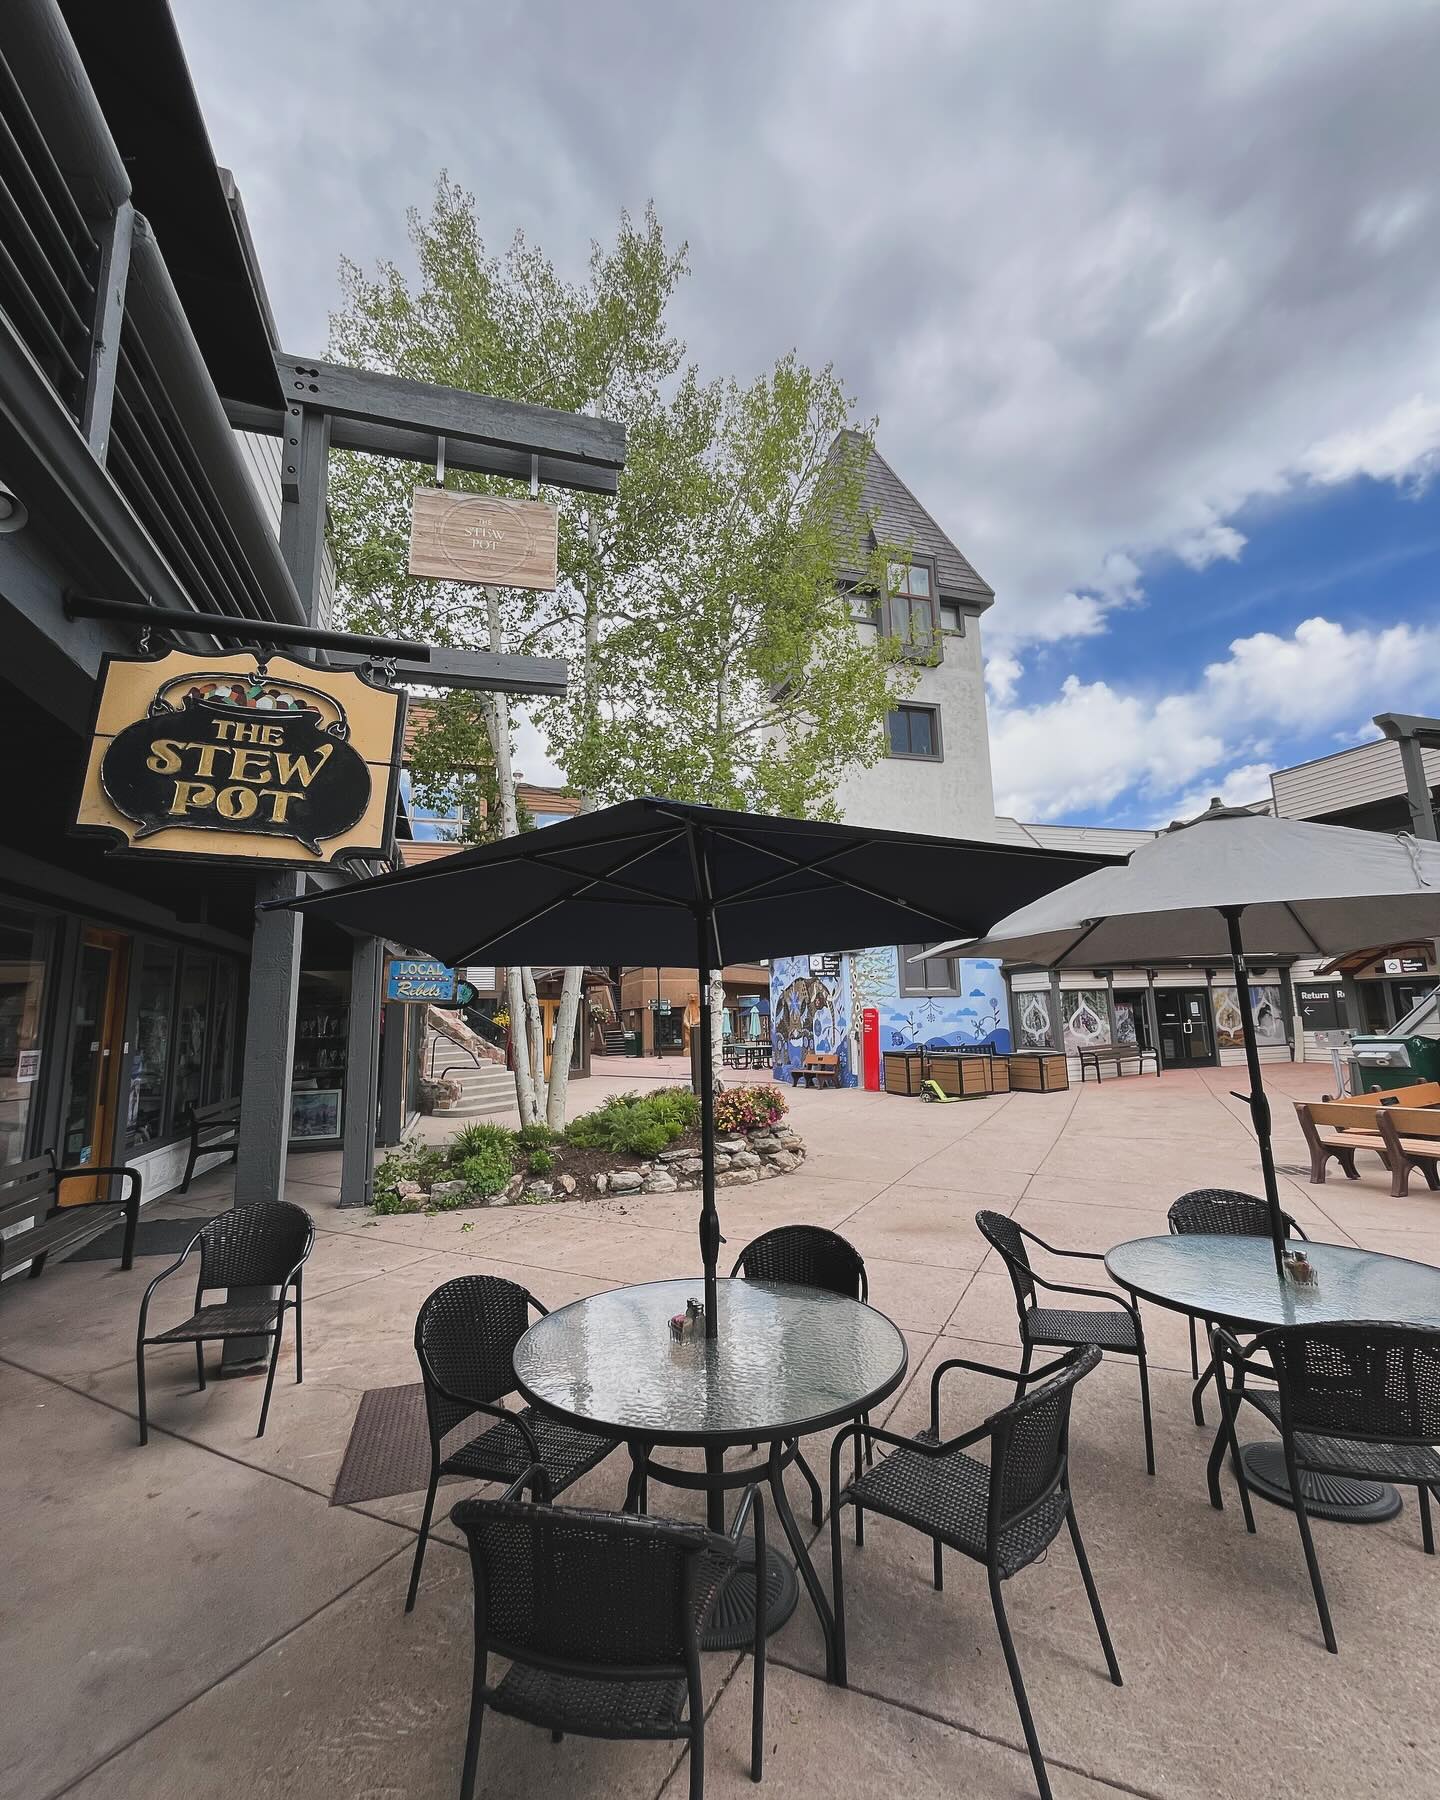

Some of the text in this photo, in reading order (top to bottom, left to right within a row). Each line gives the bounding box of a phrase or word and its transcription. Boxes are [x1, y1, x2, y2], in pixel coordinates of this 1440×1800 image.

[464, 527, 505, 540] STEW
[472, 539, 499, 550] POT
[211, 719, 285, 746] THE
[146, 739, 334, 788] STEW
[168, 780, 305, 824] POT
[400, 963, 443, 975] LOCAL
[396, 981, 441, 997] Rebels
[1301, 991, 1330, 1000] Return
